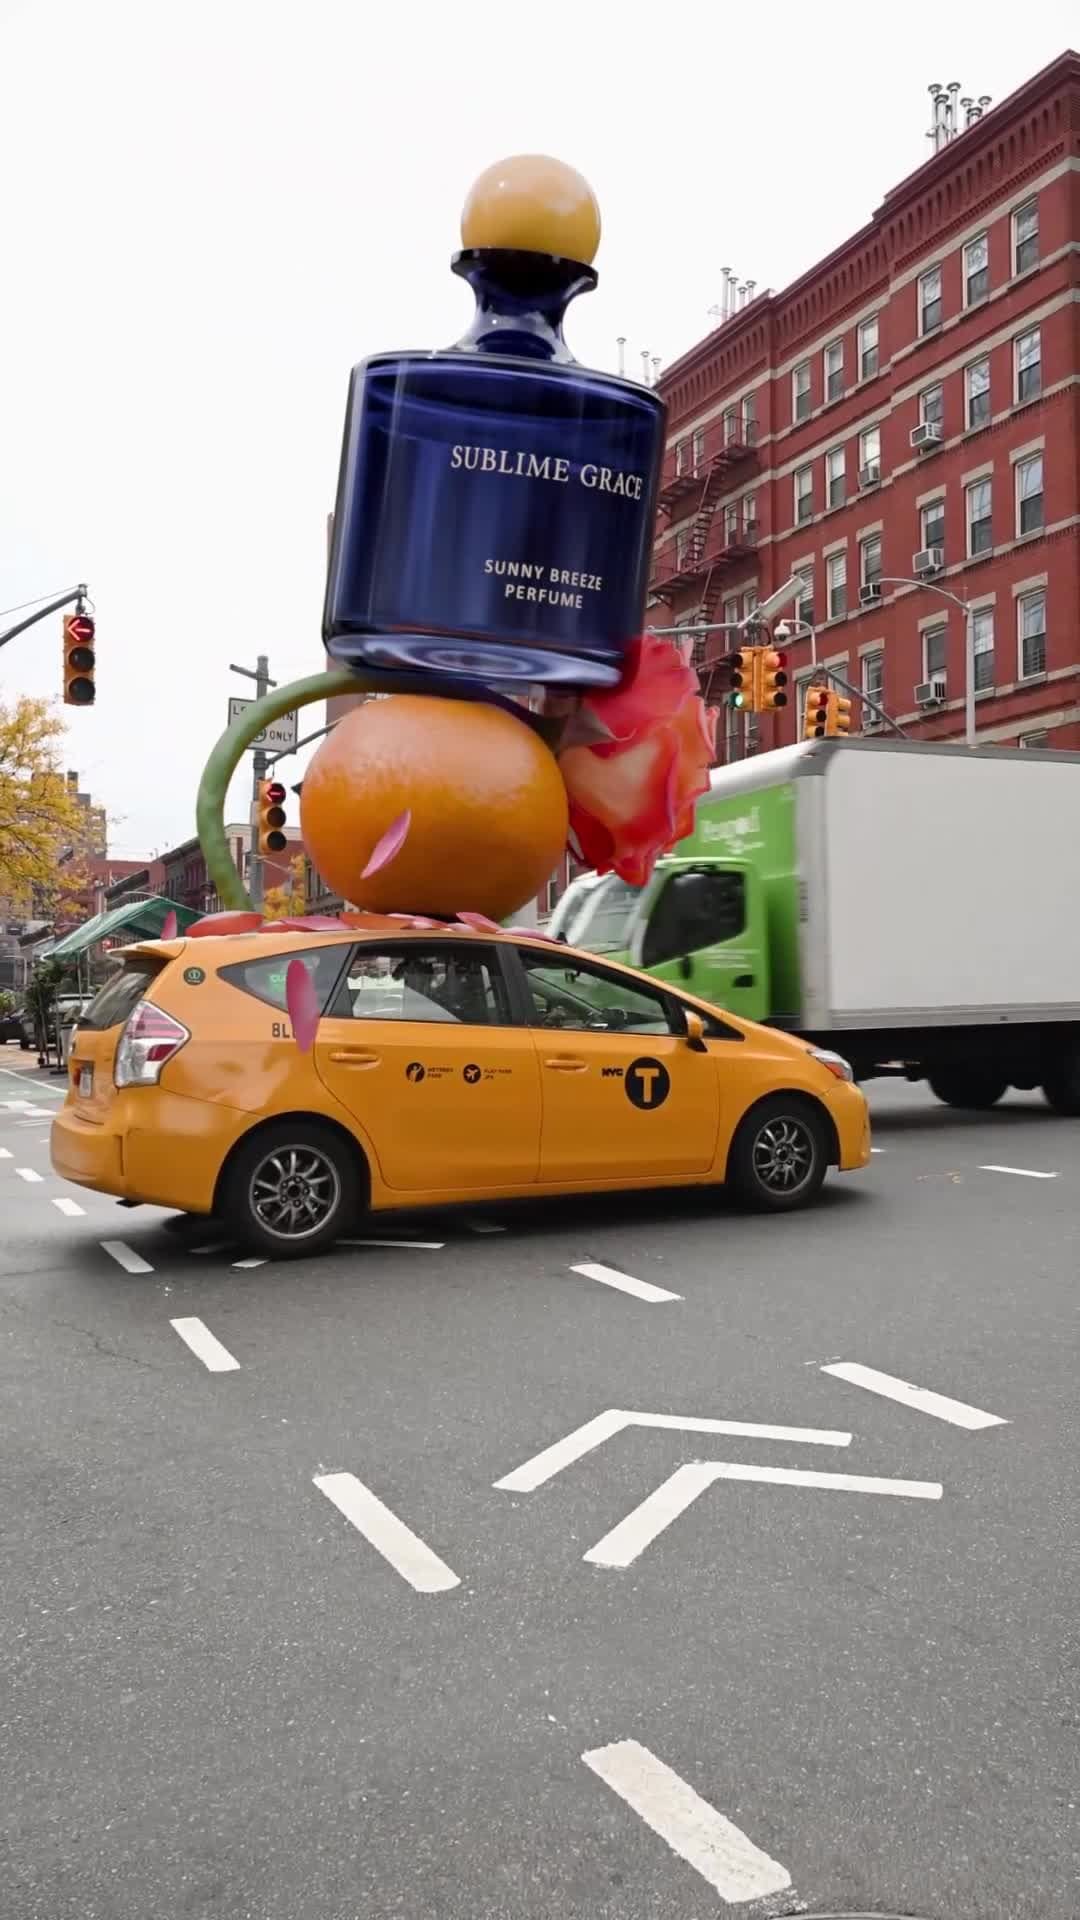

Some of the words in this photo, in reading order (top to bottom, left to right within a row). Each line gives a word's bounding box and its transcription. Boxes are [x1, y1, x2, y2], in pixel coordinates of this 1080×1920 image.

[450, 445, 570, 482] SUBLIME
[580, 464, 643, 500] GRACE
[484, 559, 544, 579] SUNNY
[550, 568, 602, 590] BREEZE
[504, 584, 583, 608] PERFUME
[269, 730, 293, 741] ONLY
[602, 1068, 623, 1077] NYC
[635, 1068, 659, 1102] T
